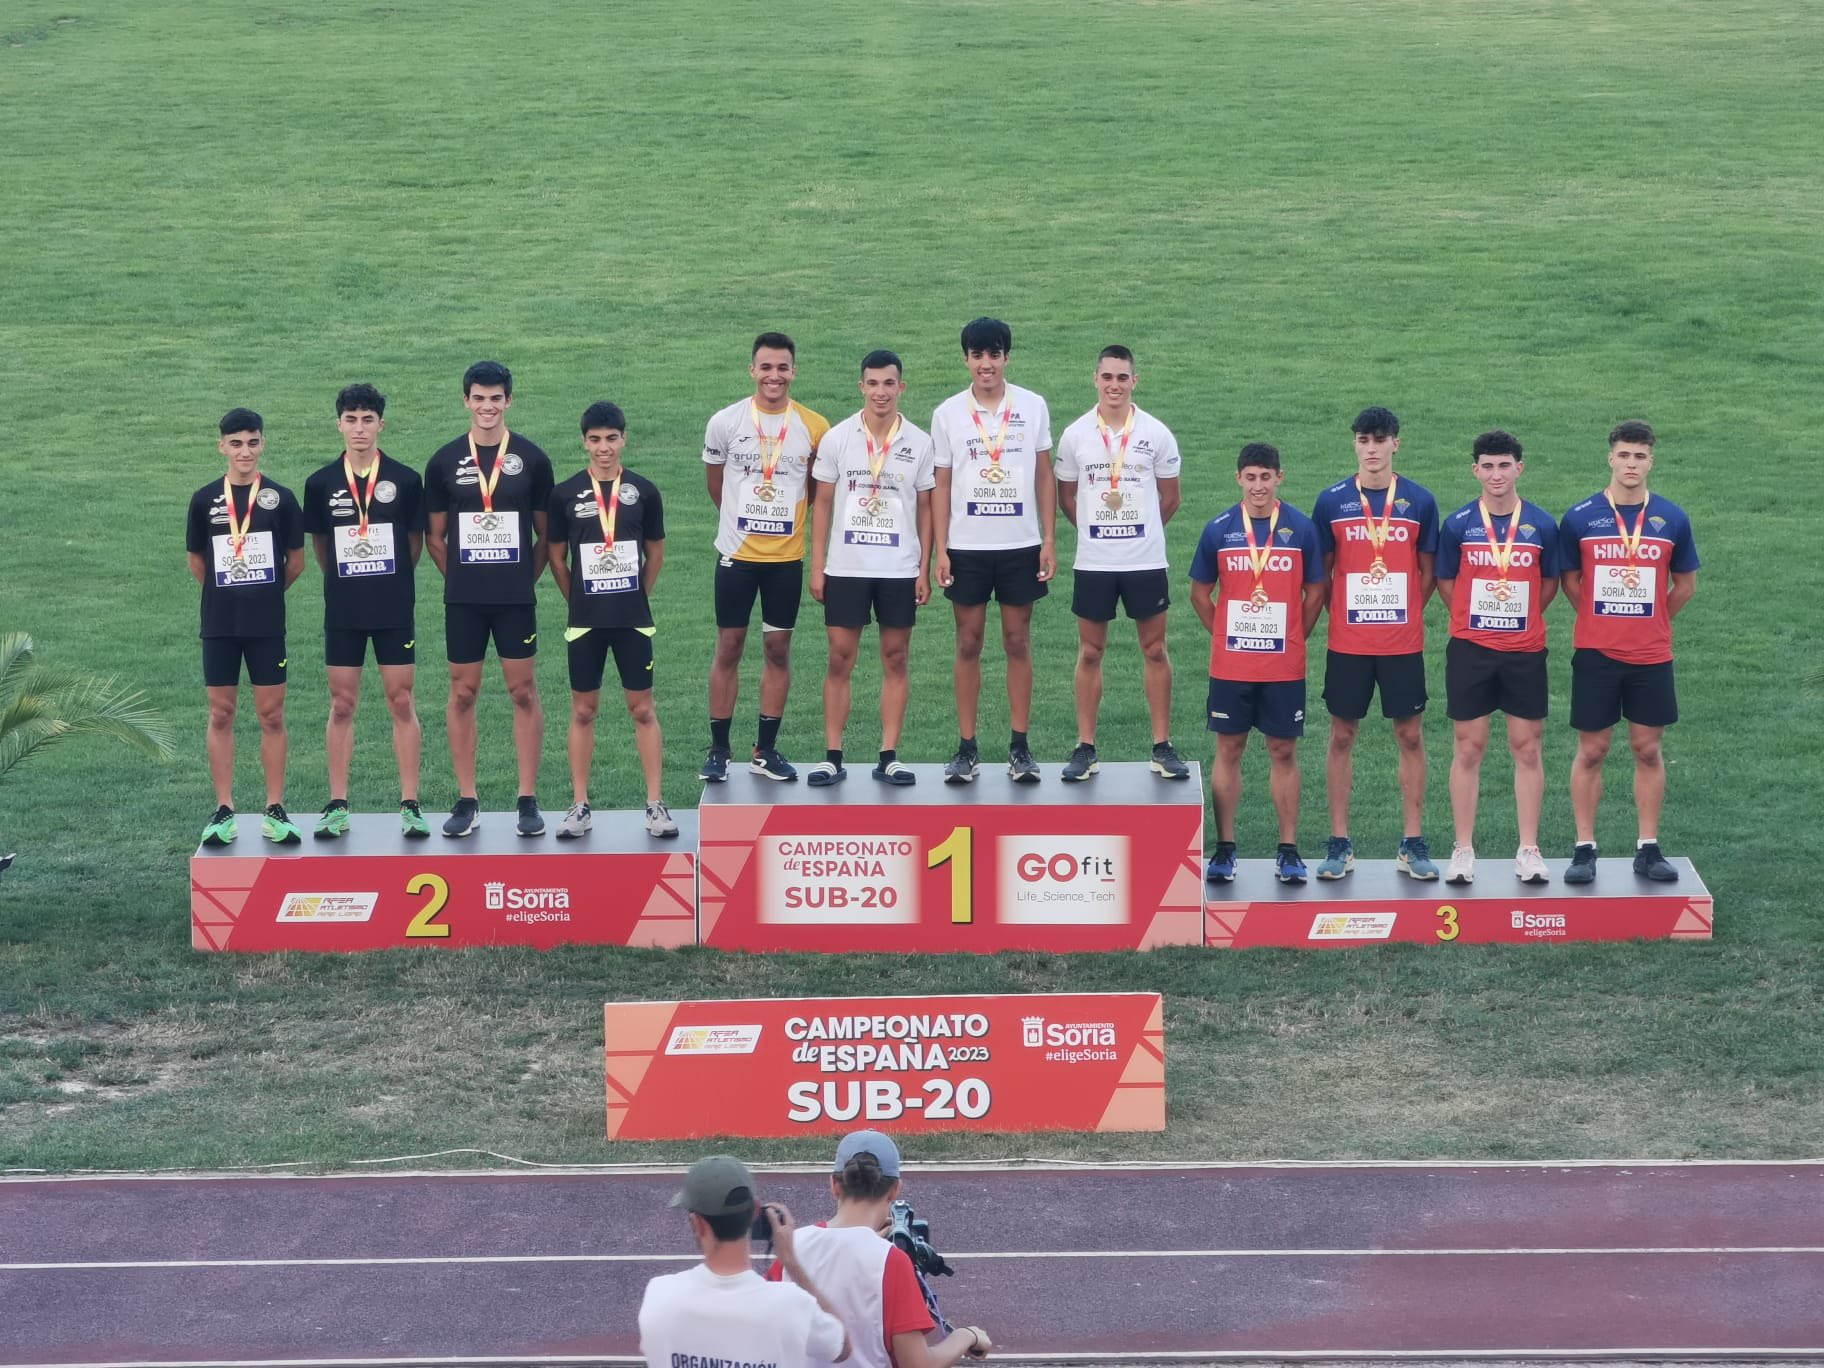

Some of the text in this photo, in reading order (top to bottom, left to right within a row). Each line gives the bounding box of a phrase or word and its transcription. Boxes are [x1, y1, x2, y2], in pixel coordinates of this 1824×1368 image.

[973, 488, 1017, 498] SORIA 2023
[745, 504, 789, 517] SORIA 2023
[1095, 510, 1139, 521] SORIA 2023
[851, 516, 894, 528] SORIA 2023
[467, 534, 512, 544] SORIA 2023
[370, 545, 387, 555] 2023
[248, 553, 267, 565] 2023
[1226, 555, 1293, 572] HINCO
[1467, 551, 1533, 568] HINCO
[615, 563, 632, 573] 2023
[1602, 586, 1647, 598] SORIA 2023
[1354, 594, 1399, 605] SORIA 2023
[1478, 600, 1522, 613] SORIA 2023
[1234, 621, 1278, 634] SORIA 2023
[778, 841, 912, 856] CAMPEONATO
[783, 856, 886, 877] de ESPAÑA
[927, 826, 972, 923] 1
[506, 888, 570, 909] Soria
[785, 886, 897, 908] SUB-20
[405, 873, 449, 937] 2
[505, 911, 571, 924] #eligeSoria
[1435, 905, 1459, 940] 3
[1525, 914, 1566, 928] Soria
[1524, 929, 1566, 937] #eligeSoria
[785, 1013, 989, 1040] CAMPEONATO
[1046, 1023, 1116, 1046] Soria
[792, 1037, 990, 1072] de ESPAÑA 2023
[1045, 1049, 1117, 1063] #eligeSoria
[787, 1078, 991, 1122] SUB-20
